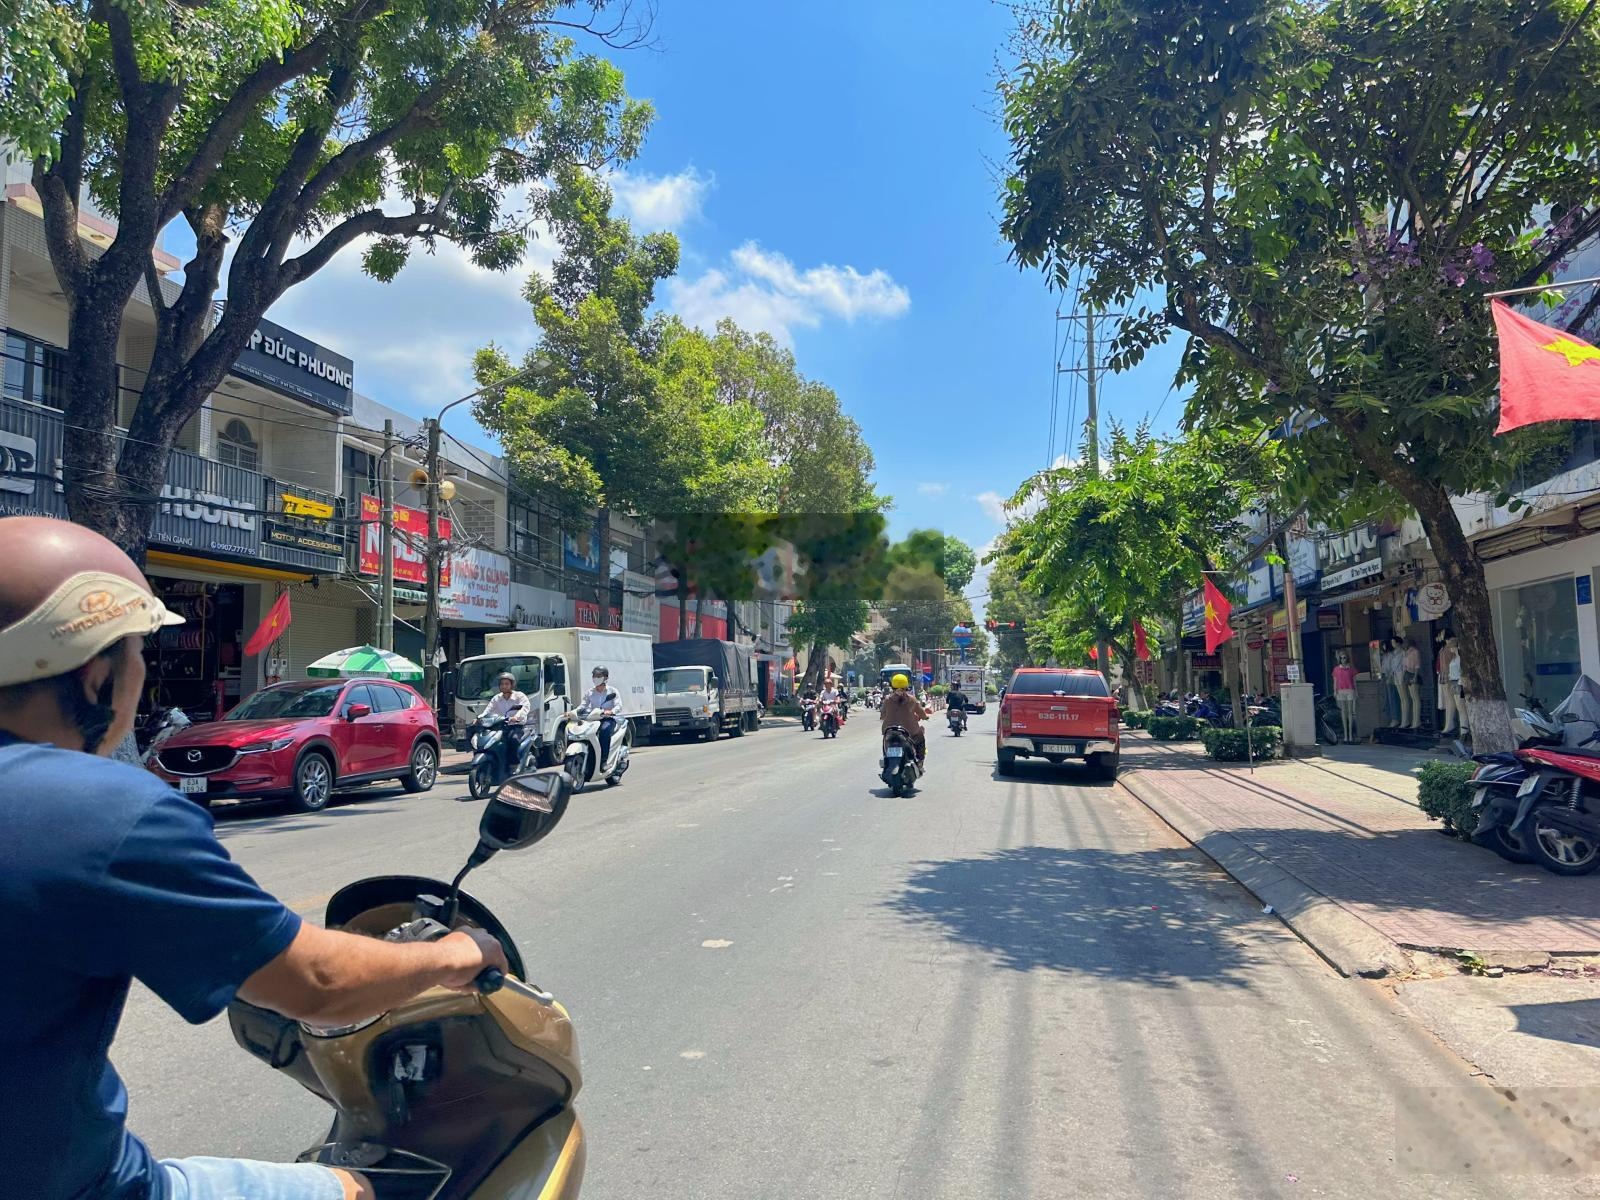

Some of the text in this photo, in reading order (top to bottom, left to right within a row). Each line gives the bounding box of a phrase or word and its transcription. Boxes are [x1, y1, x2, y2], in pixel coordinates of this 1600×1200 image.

[265, 338, 296, 365] ĐỨC
[298, 351, 352, 390] PHƯƠNG
[172, 535, 193, 546] GIANG
[271, 531, 342, 552] MOTOR ACCESSORIES
